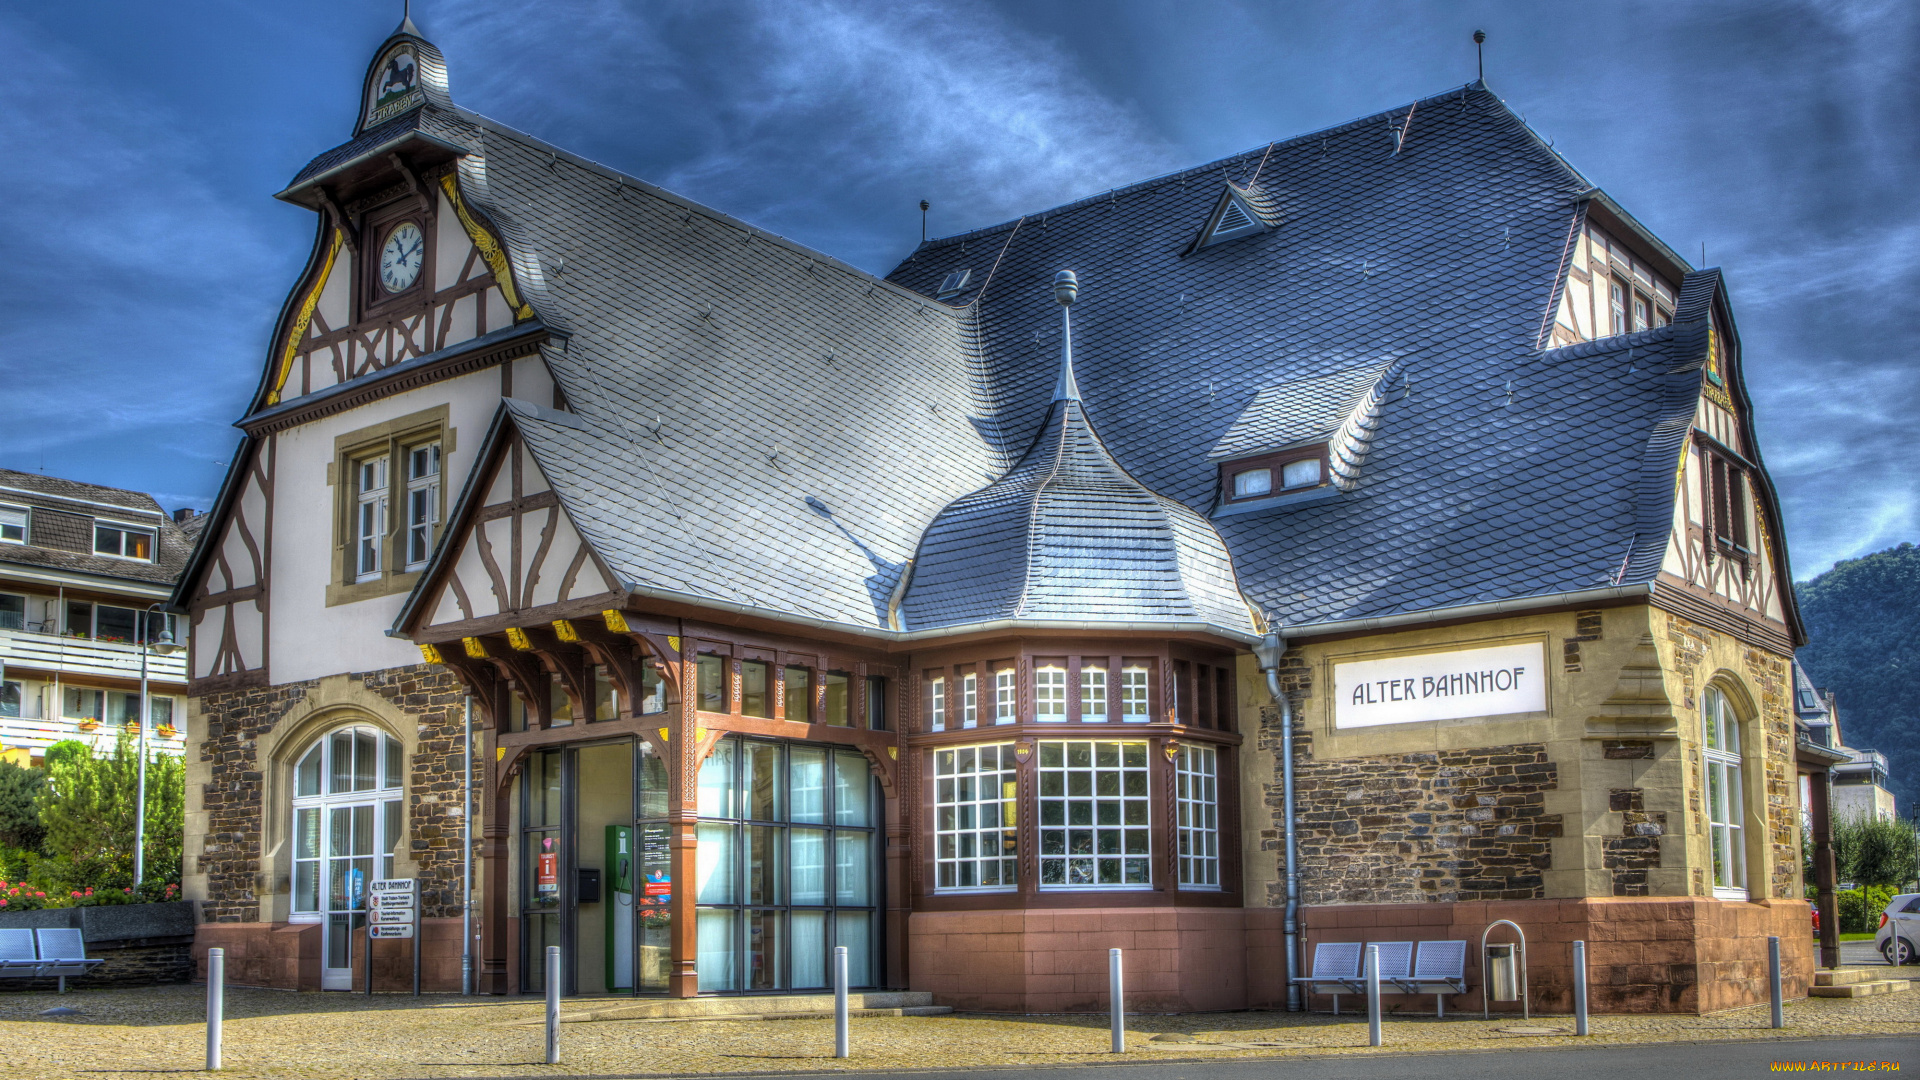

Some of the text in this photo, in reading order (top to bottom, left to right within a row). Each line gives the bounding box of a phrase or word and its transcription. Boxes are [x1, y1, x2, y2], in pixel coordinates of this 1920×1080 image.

[377, 95, 412, 119] TRABEN
[1352, 667, 1525, 705] ALTER BAHNHOF
[372, 882, 386, 890] ALTER
[388, 881, 411, 890] BAHNHOF
